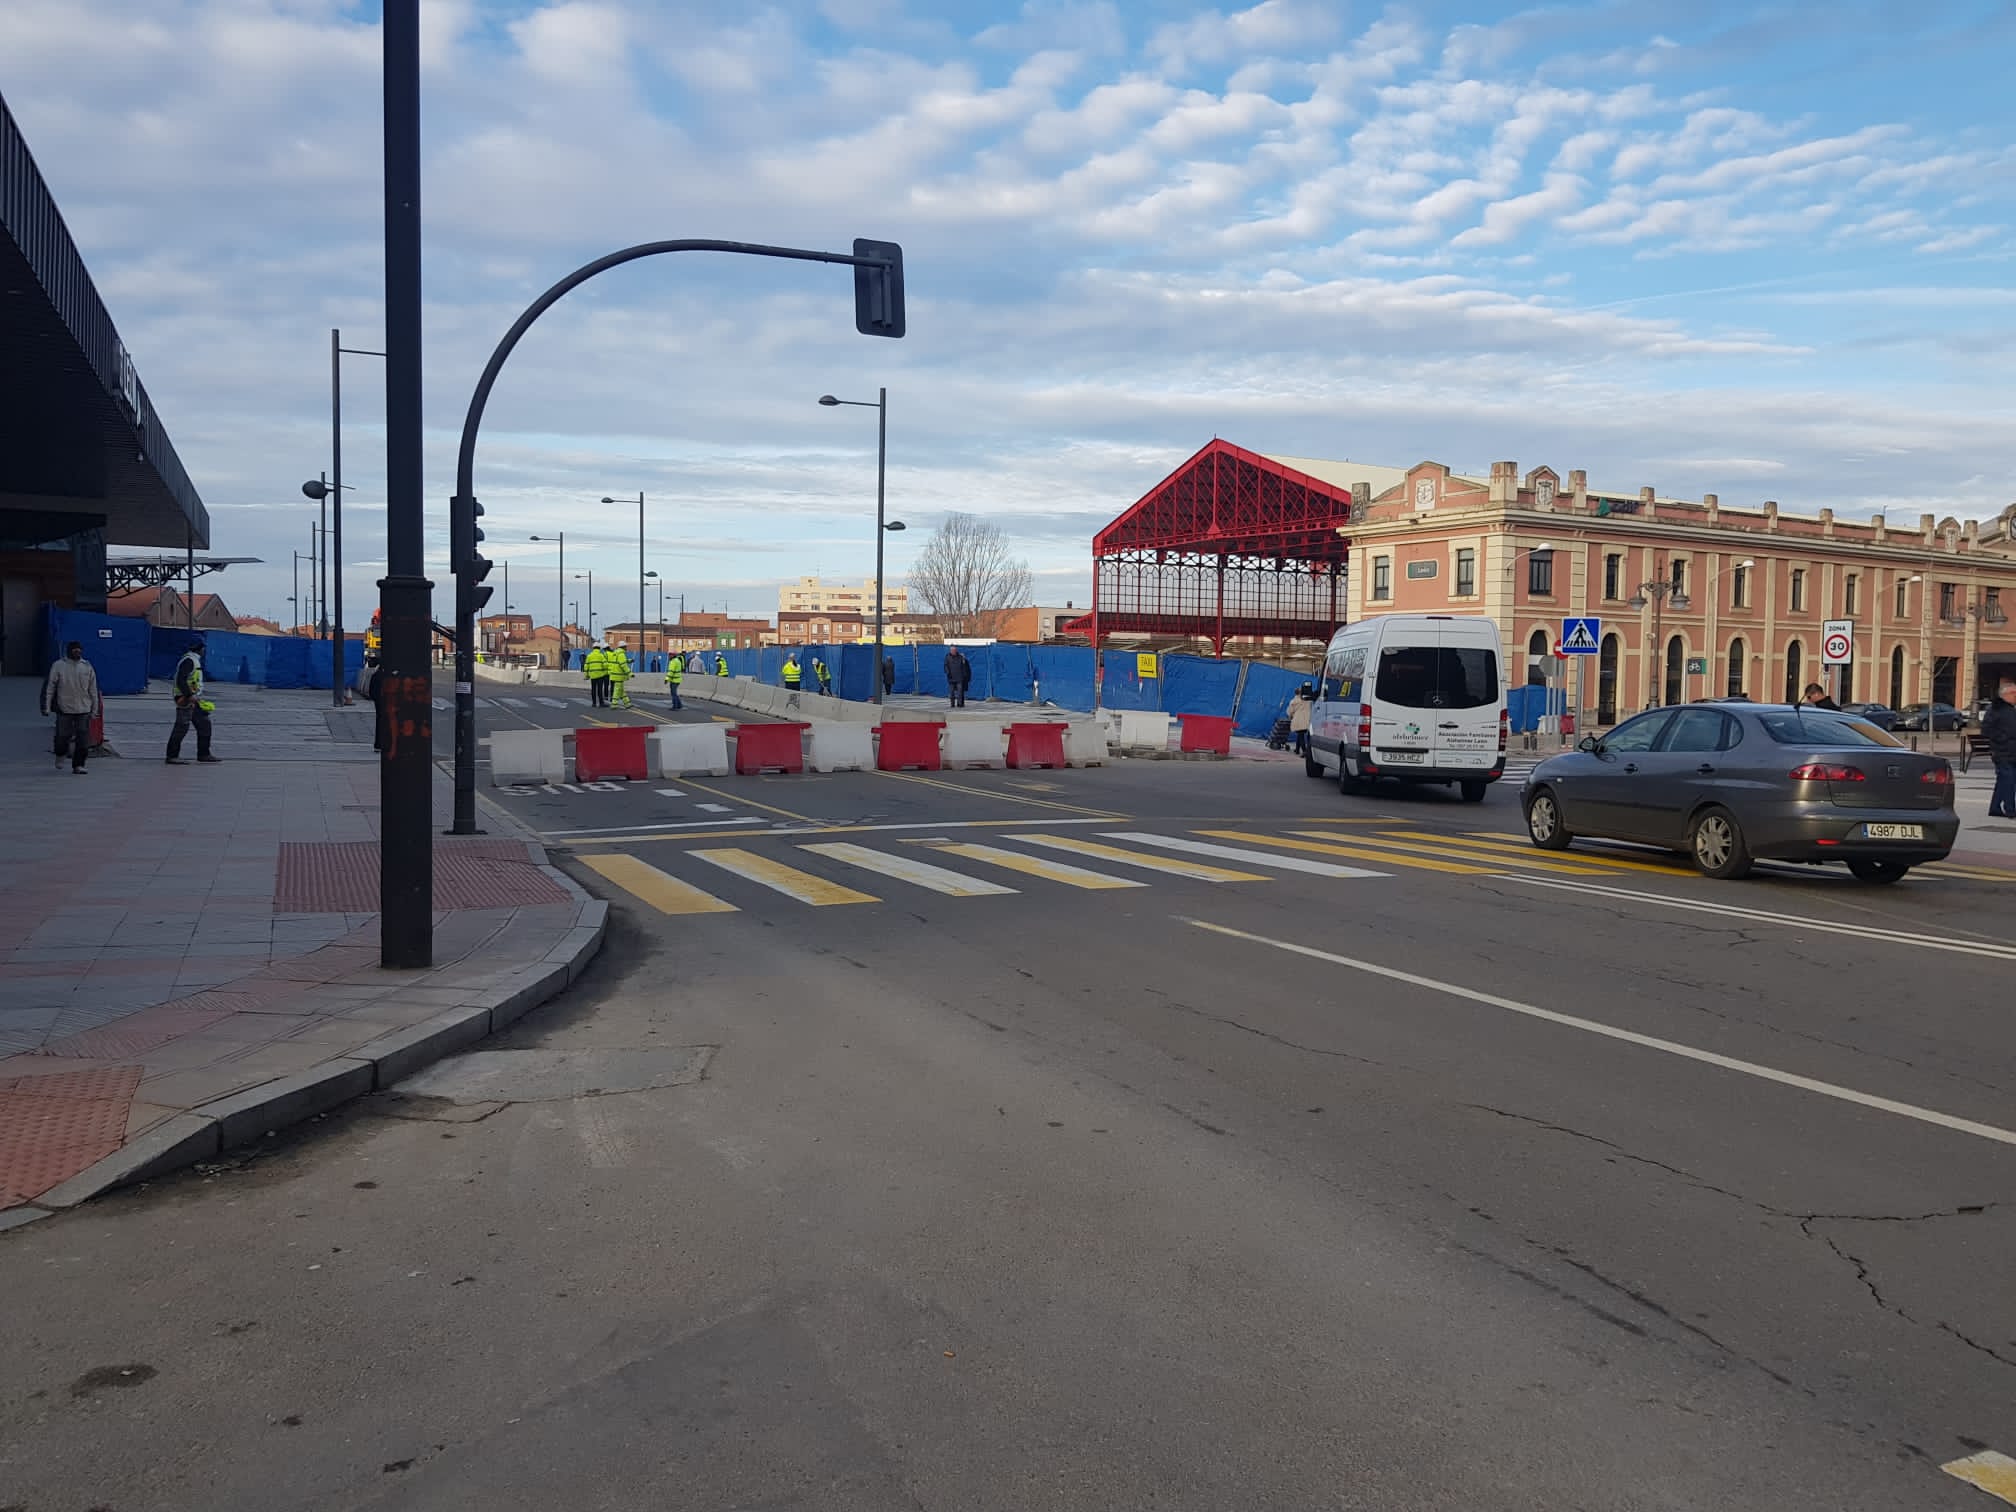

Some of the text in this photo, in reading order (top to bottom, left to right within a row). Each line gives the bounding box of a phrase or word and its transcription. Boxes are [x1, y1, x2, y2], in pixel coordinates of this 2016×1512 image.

[1830, 641, 1845, 650] 30
[498, 782, 629, 797] BUS
[1870, 825, 1919, 838] 4987 DJL
